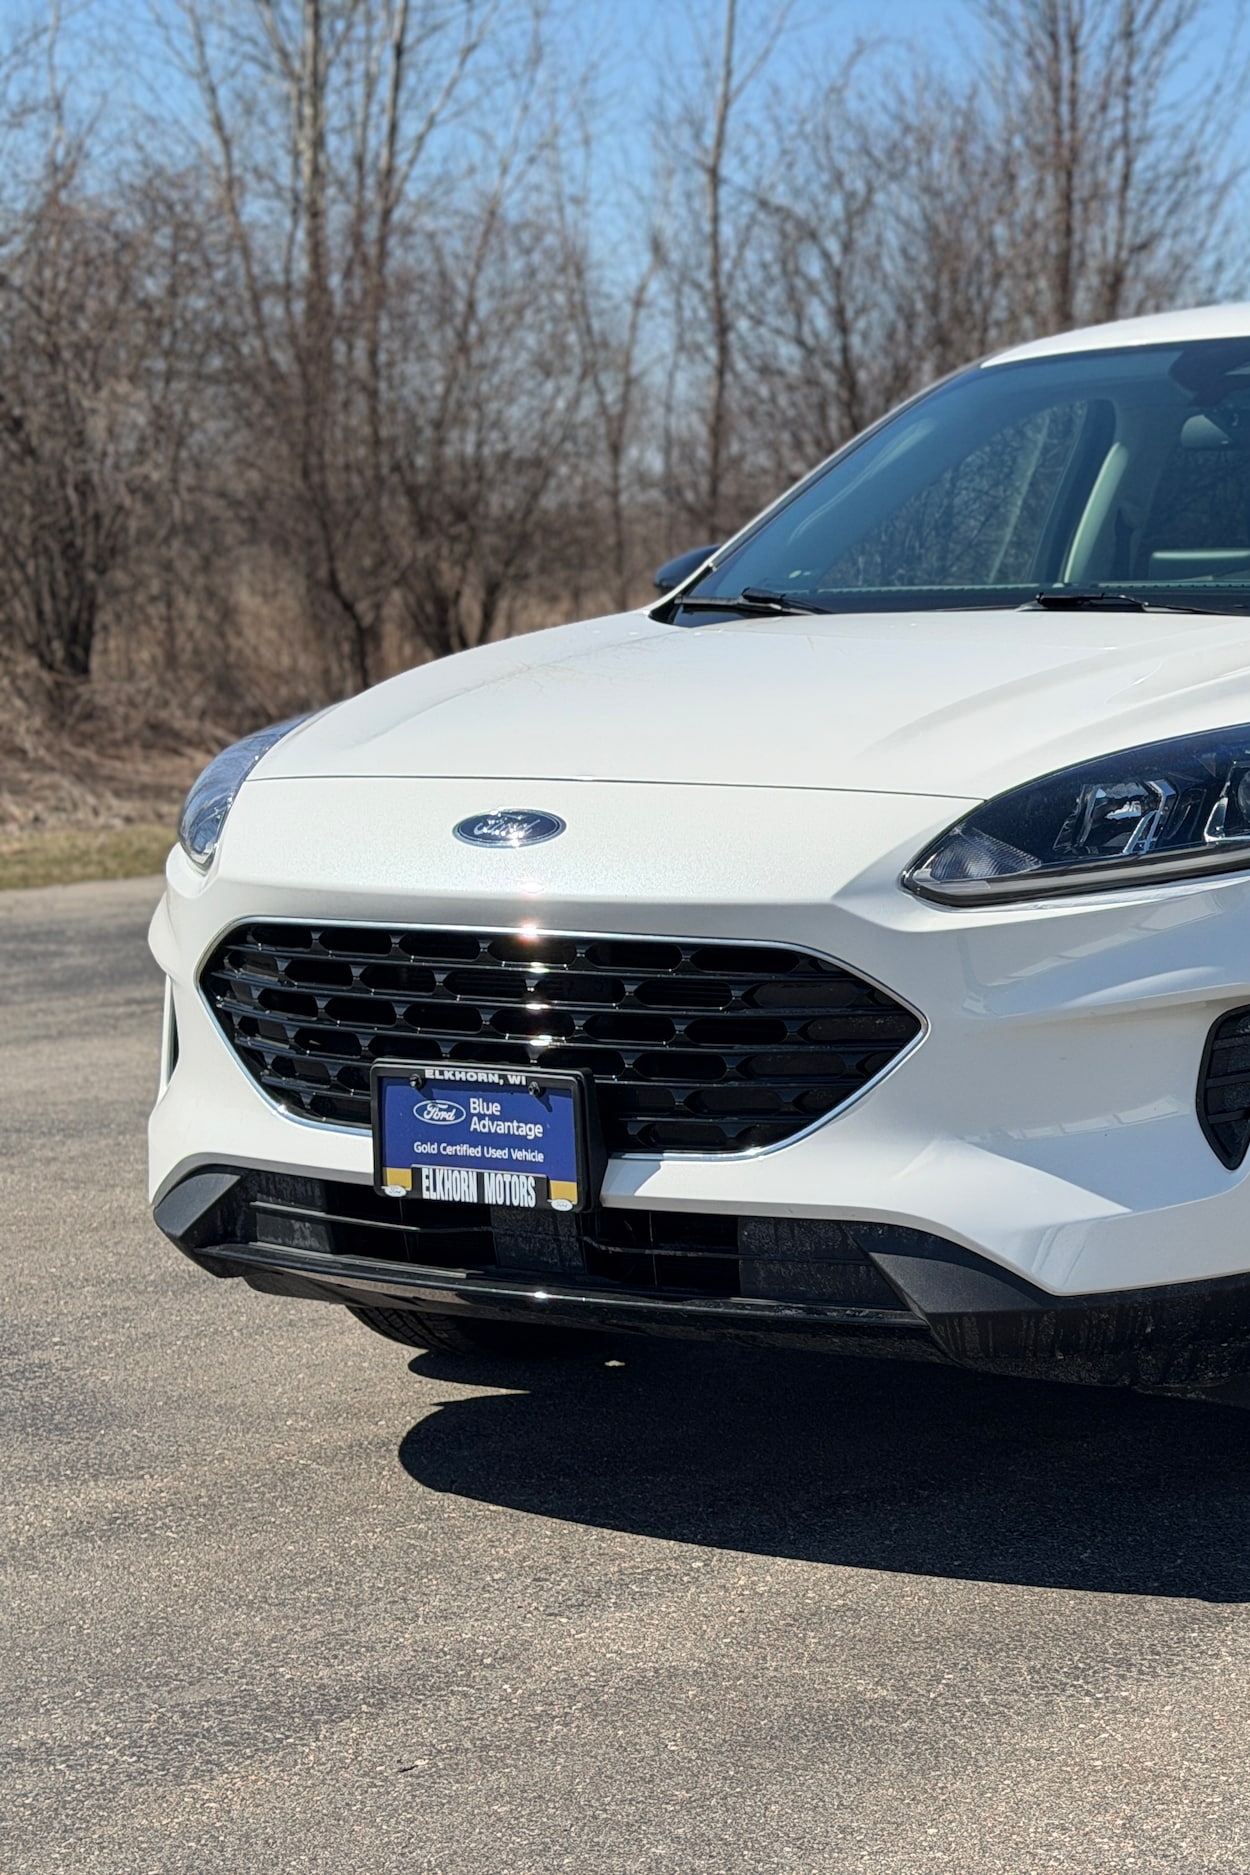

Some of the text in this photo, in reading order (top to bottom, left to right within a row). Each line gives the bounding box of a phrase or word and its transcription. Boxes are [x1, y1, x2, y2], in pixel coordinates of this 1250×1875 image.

[425, 1069, 527, 1085] ELKHORN, WI
[423, 1103, 456, 1121] Ford
[469, 1098, 501, 1115] Blue
[470, 1117, 543, 1139] Advantage
[413, 1142, 544, 1163] Gold Certified Used Vehicle
[421, 1168, 536, 1208] ELKHORN MOTORS
